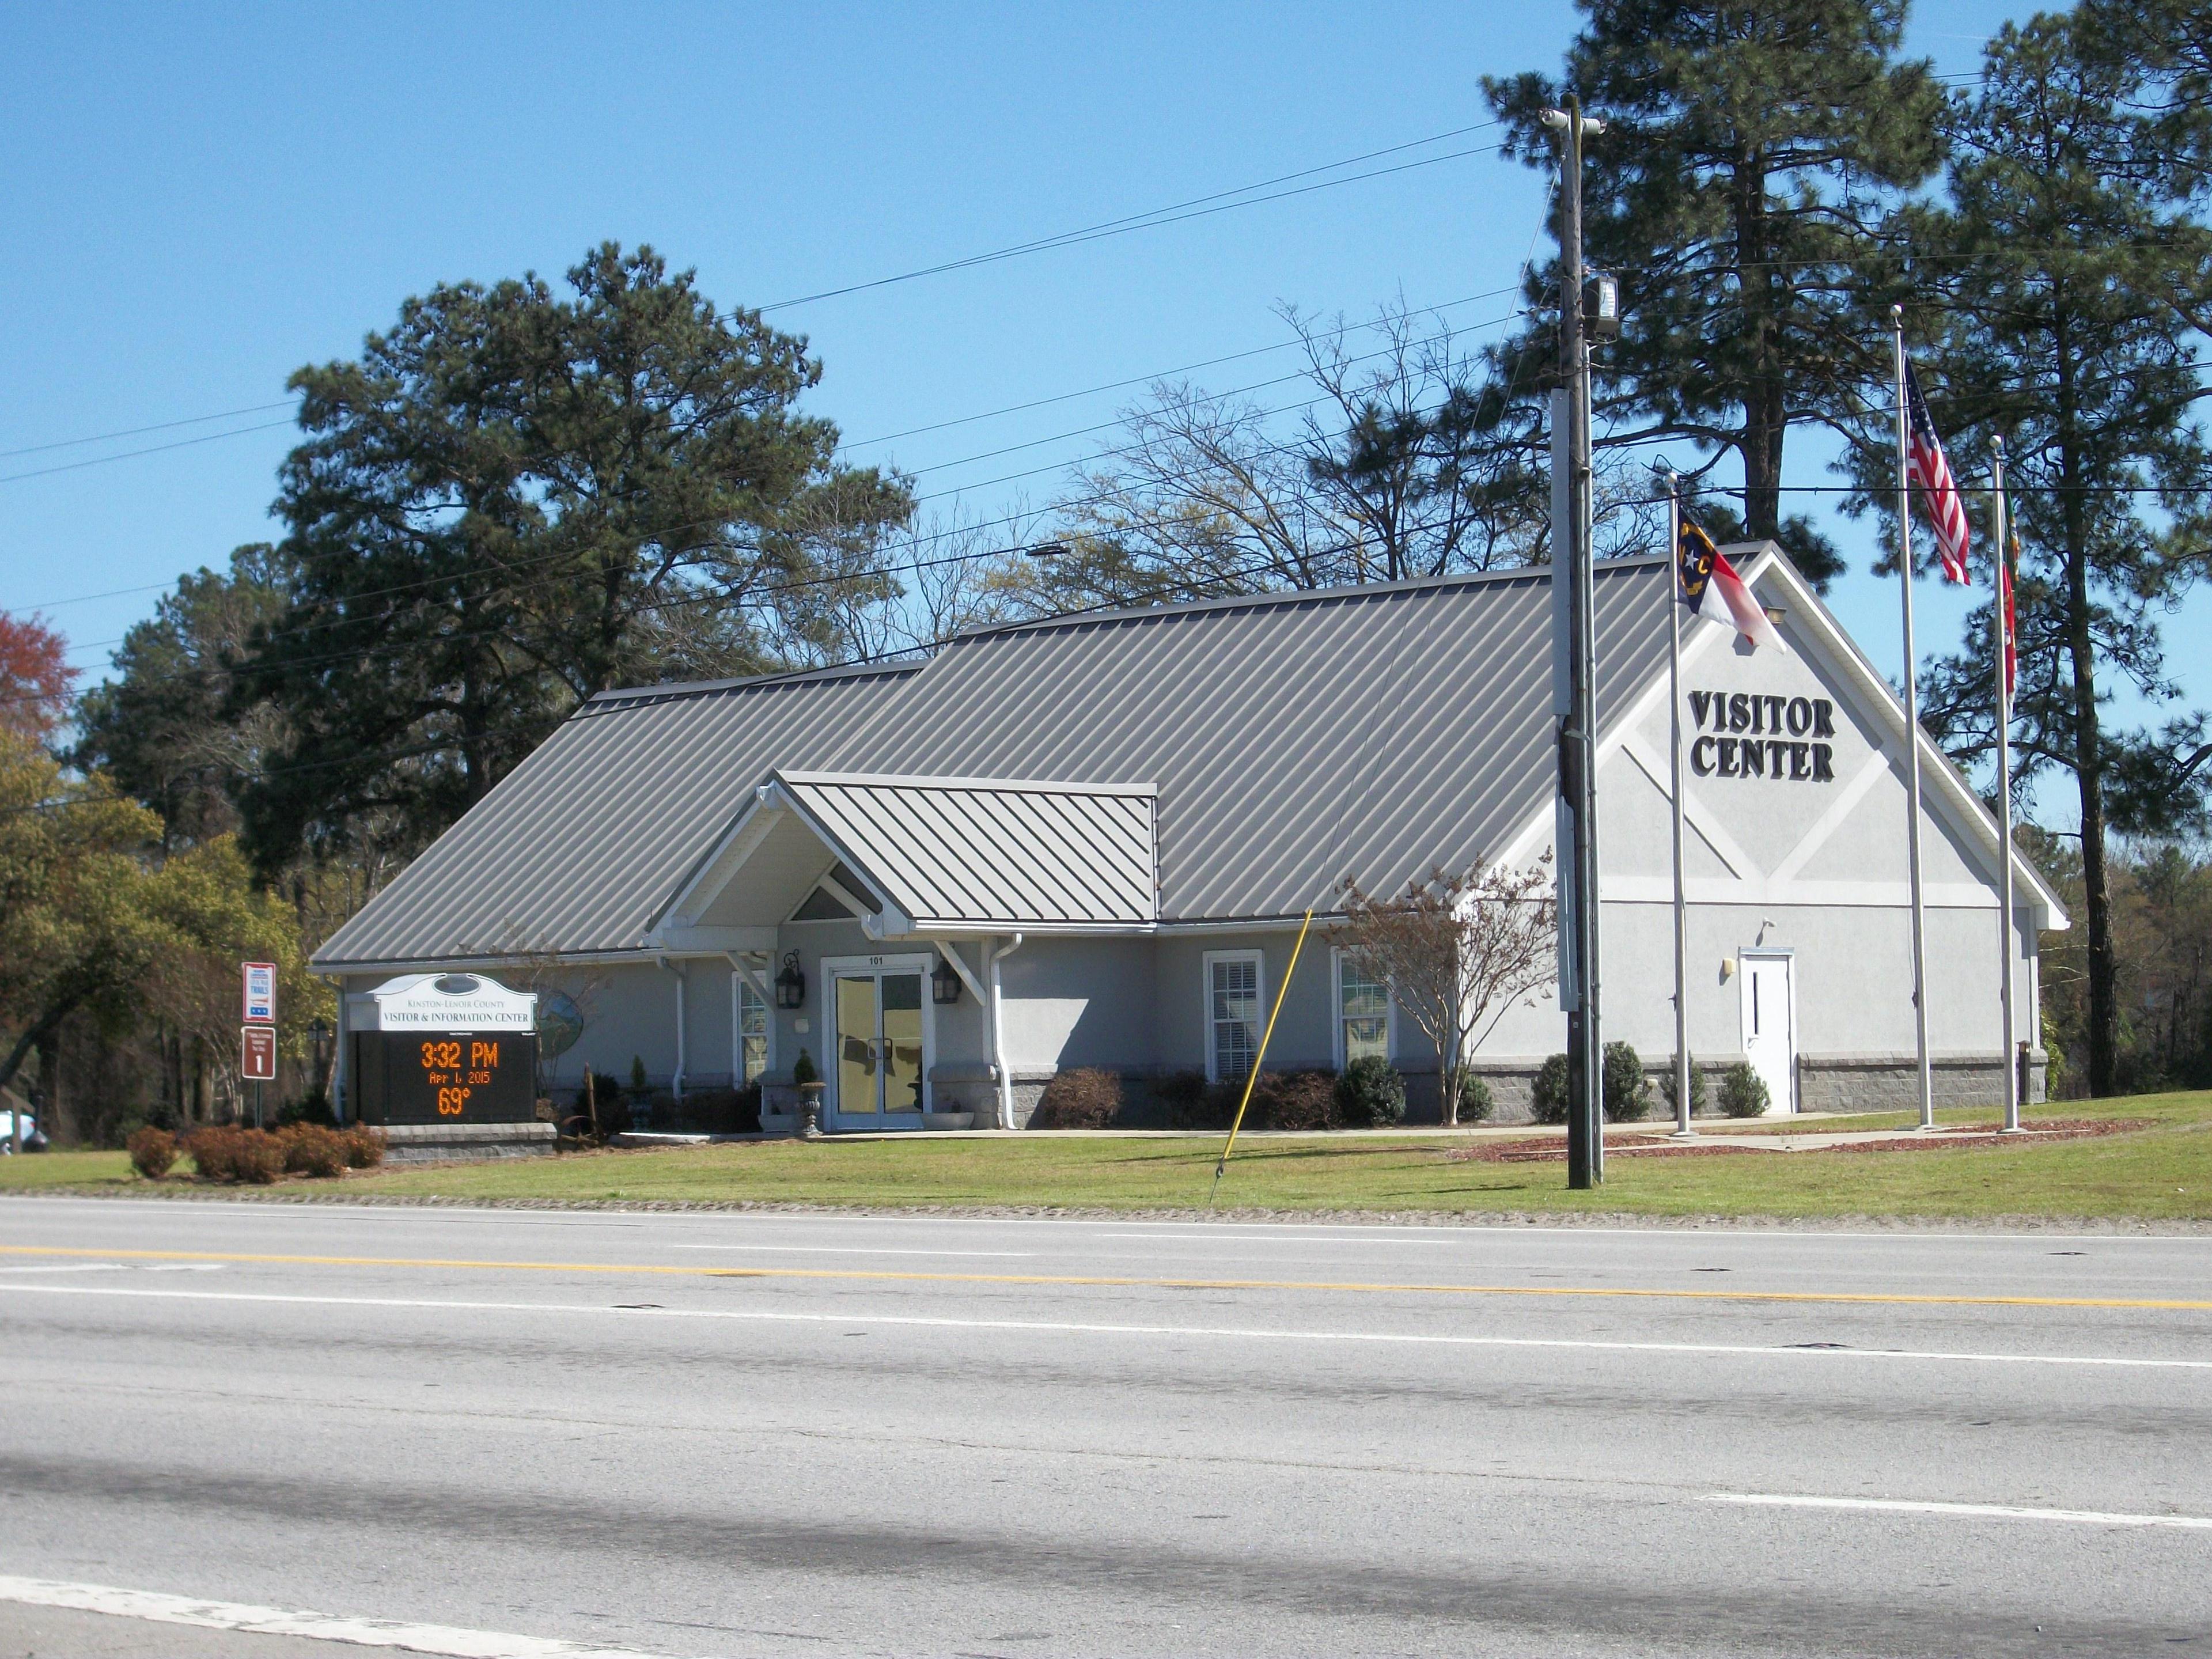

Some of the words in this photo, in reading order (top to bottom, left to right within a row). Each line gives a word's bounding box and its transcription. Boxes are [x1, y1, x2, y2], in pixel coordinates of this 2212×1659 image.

[1687, 690, 1836, 738] VISITOR
[1690, 735, 1835, 783] CENTER
[869, 956, 882, 965] 101
[473, 999, 505, 1008] COUNTY
[384, 1012, 419, 1022] VISITOR
[421, 1013, 429, 1022] &
[431, 1013, 493, 1022] INFORMATION
[495, 1013, 529, 1023] CENTER
[421, 1041, 461, 1068] 3:32
[472, 1041, 498, 1068] PM
[255, 1055, 262, 1073] 1
[429, 1071, 449, 1084] Apr
[468, 1071, 491, 1084] 2015
[438, 1087, 471, 1115] 69°
